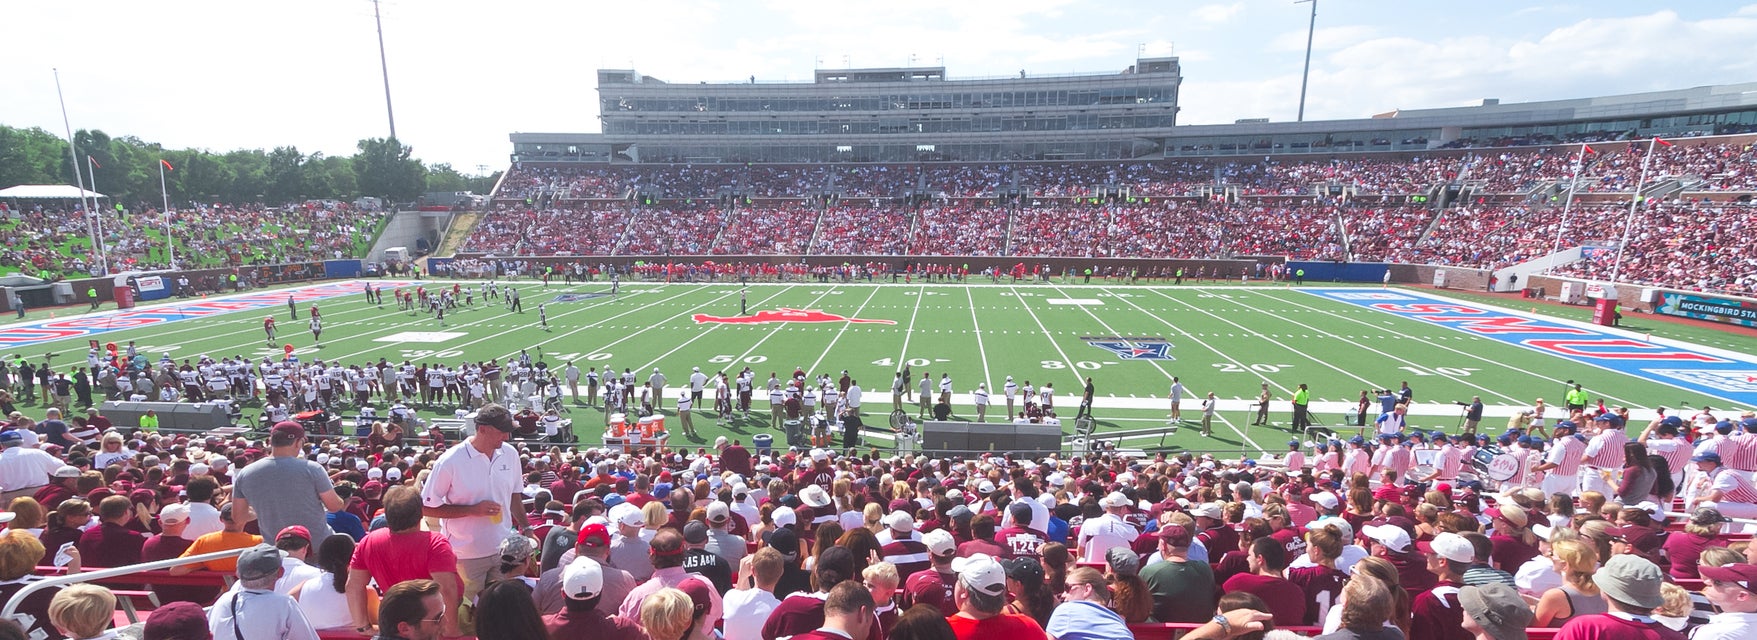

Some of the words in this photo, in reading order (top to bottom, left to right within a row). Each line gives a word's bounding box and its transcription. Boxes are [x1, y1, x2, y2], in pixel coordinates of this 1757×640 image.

[1681, 302, 1740, 316] MOCKINGBIRD
[1740, 310, 1757, 318] STA
[1369, 303, 1737, 363] SMU
[708, 354, 768, 363] 50
[871, 357, 931, 367] 40
[1040, 360, 1102, 370] 30
[1211, 363, 1281, 373] 20
[1398, 366, 1474, 377] 10
[700, 554, 716, 566] A&M
